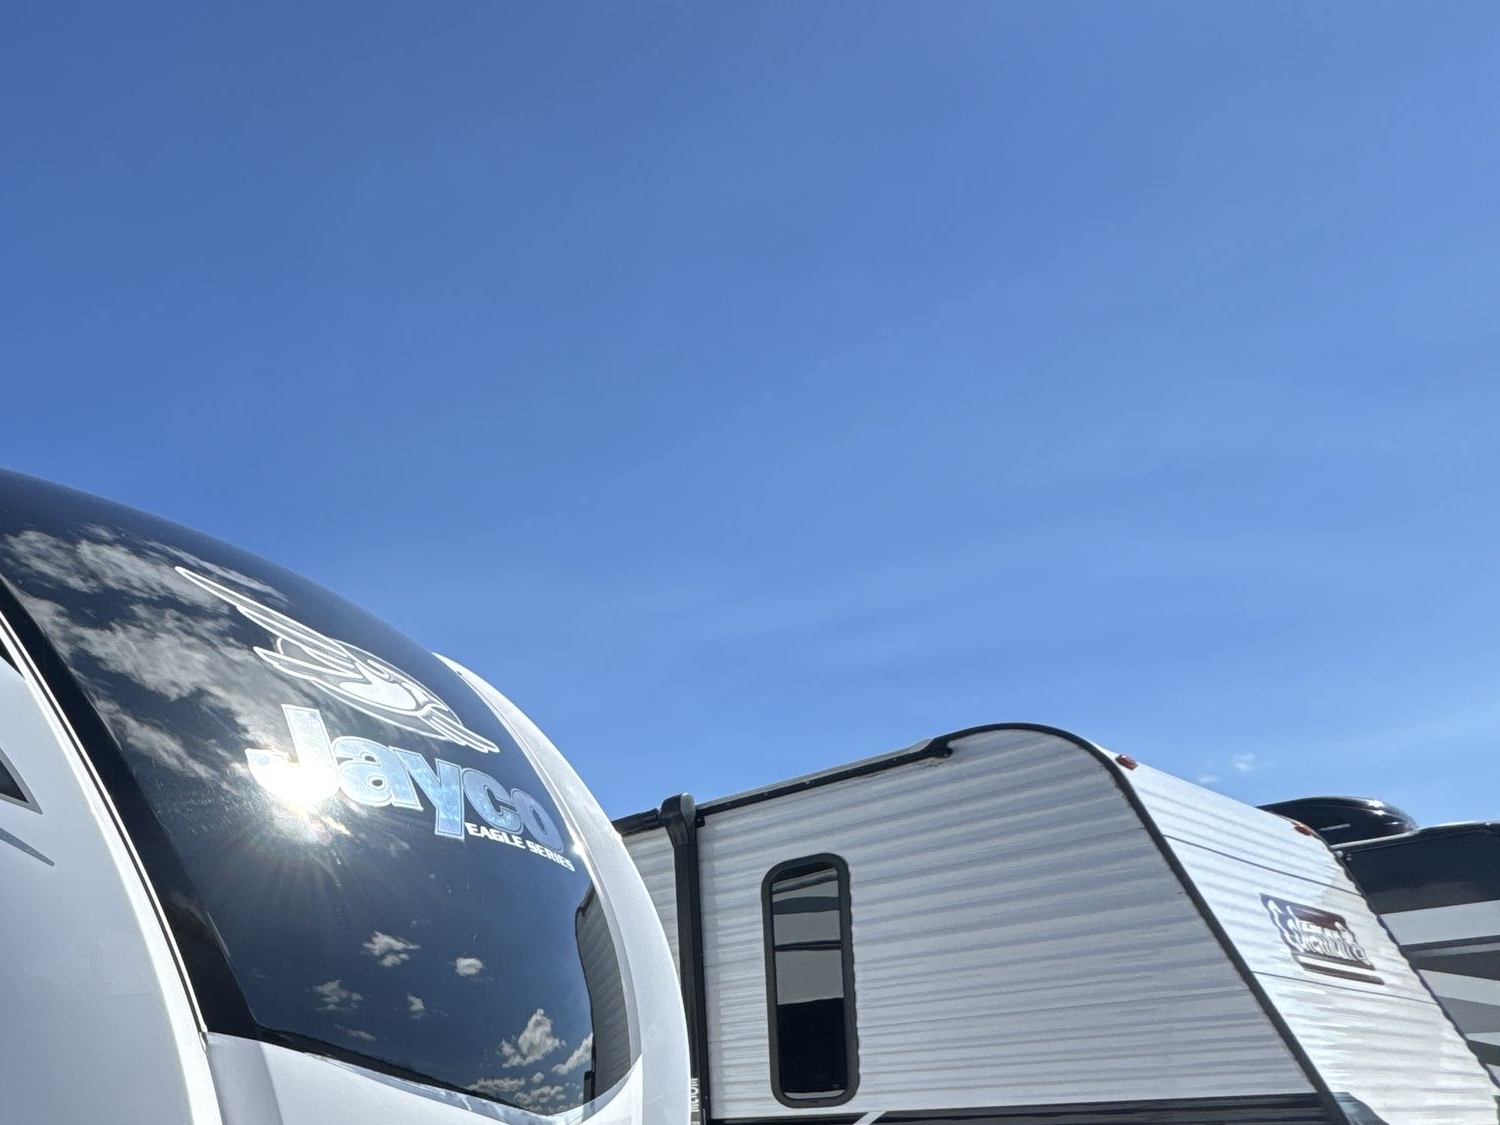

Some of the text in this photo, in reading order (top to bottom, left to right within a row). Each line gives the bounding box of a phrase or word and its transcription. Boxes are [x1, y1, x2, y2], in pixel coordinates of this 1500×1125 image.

[244, 703, 565, 853] Jayco
[464, 822, 576, 872] EAGLE SERIES
